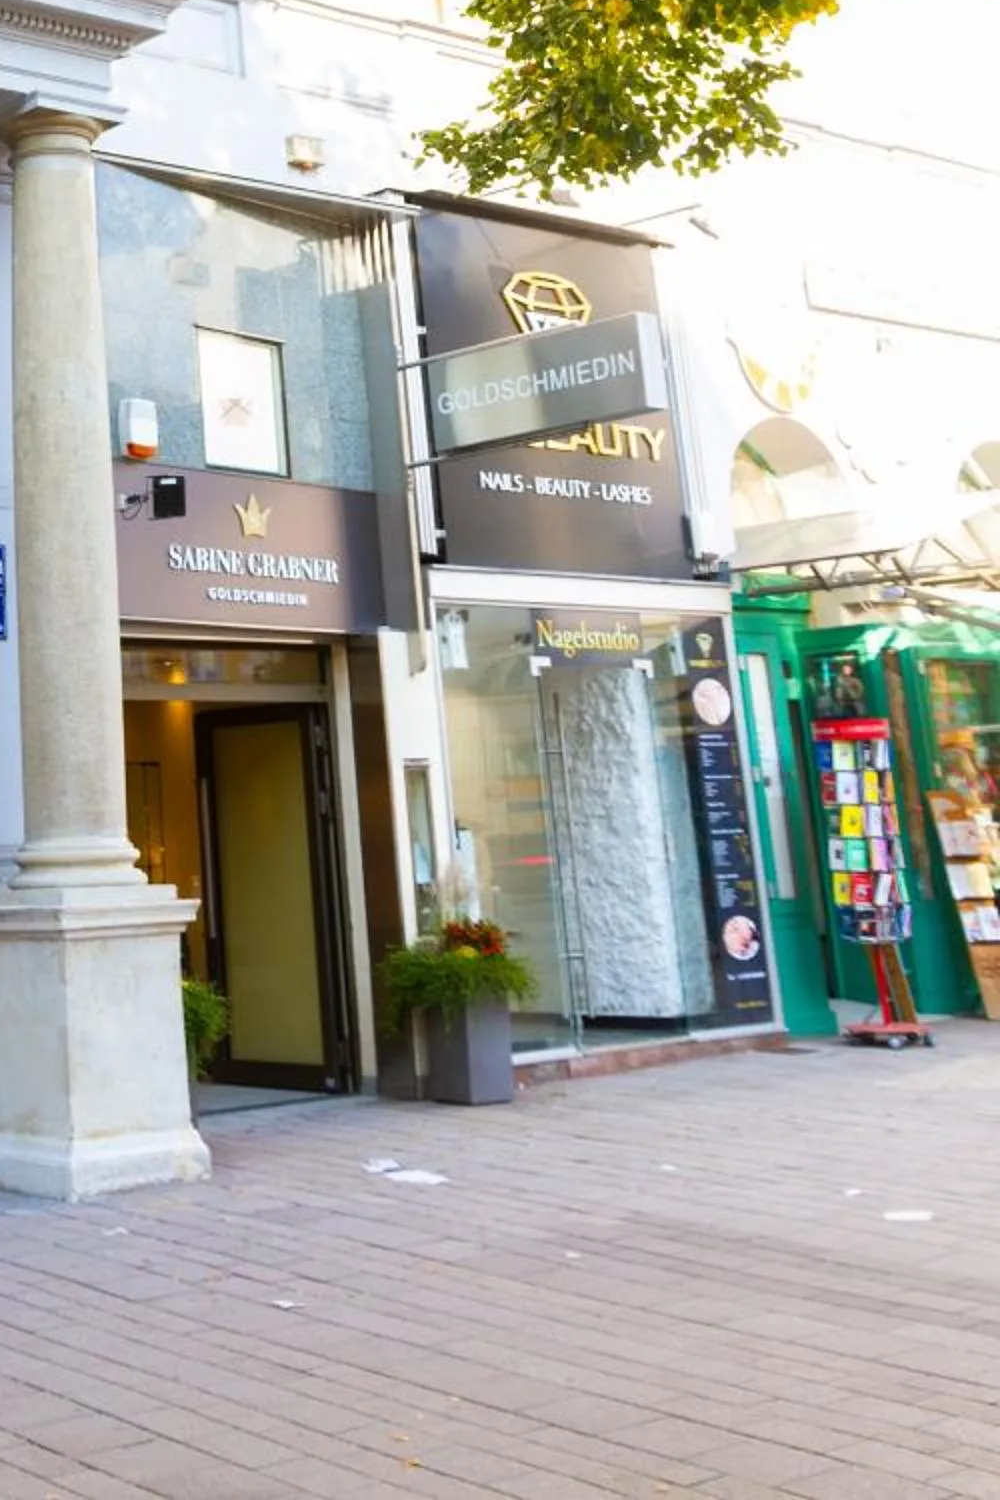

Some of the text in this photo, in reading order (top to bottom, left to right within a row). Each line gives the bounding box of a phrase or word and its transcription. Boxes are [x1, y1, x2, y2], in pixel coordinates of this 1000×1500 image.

[437, 349, 636, 414] GOLDSCHMIEDIN
[528, 421, 666, 461] AUTY
[479, 470, 525, 493] NAILS
[535, 477, 591, 499] BEAUTY
[601, 483, 652, 505] LASHES
[168, 543, 339, 584] SABINE GRABNER
[207, 586, 308, 606] GOLDSCHMIEDIN
[536, 619, 640, 659] Nagelstudio
